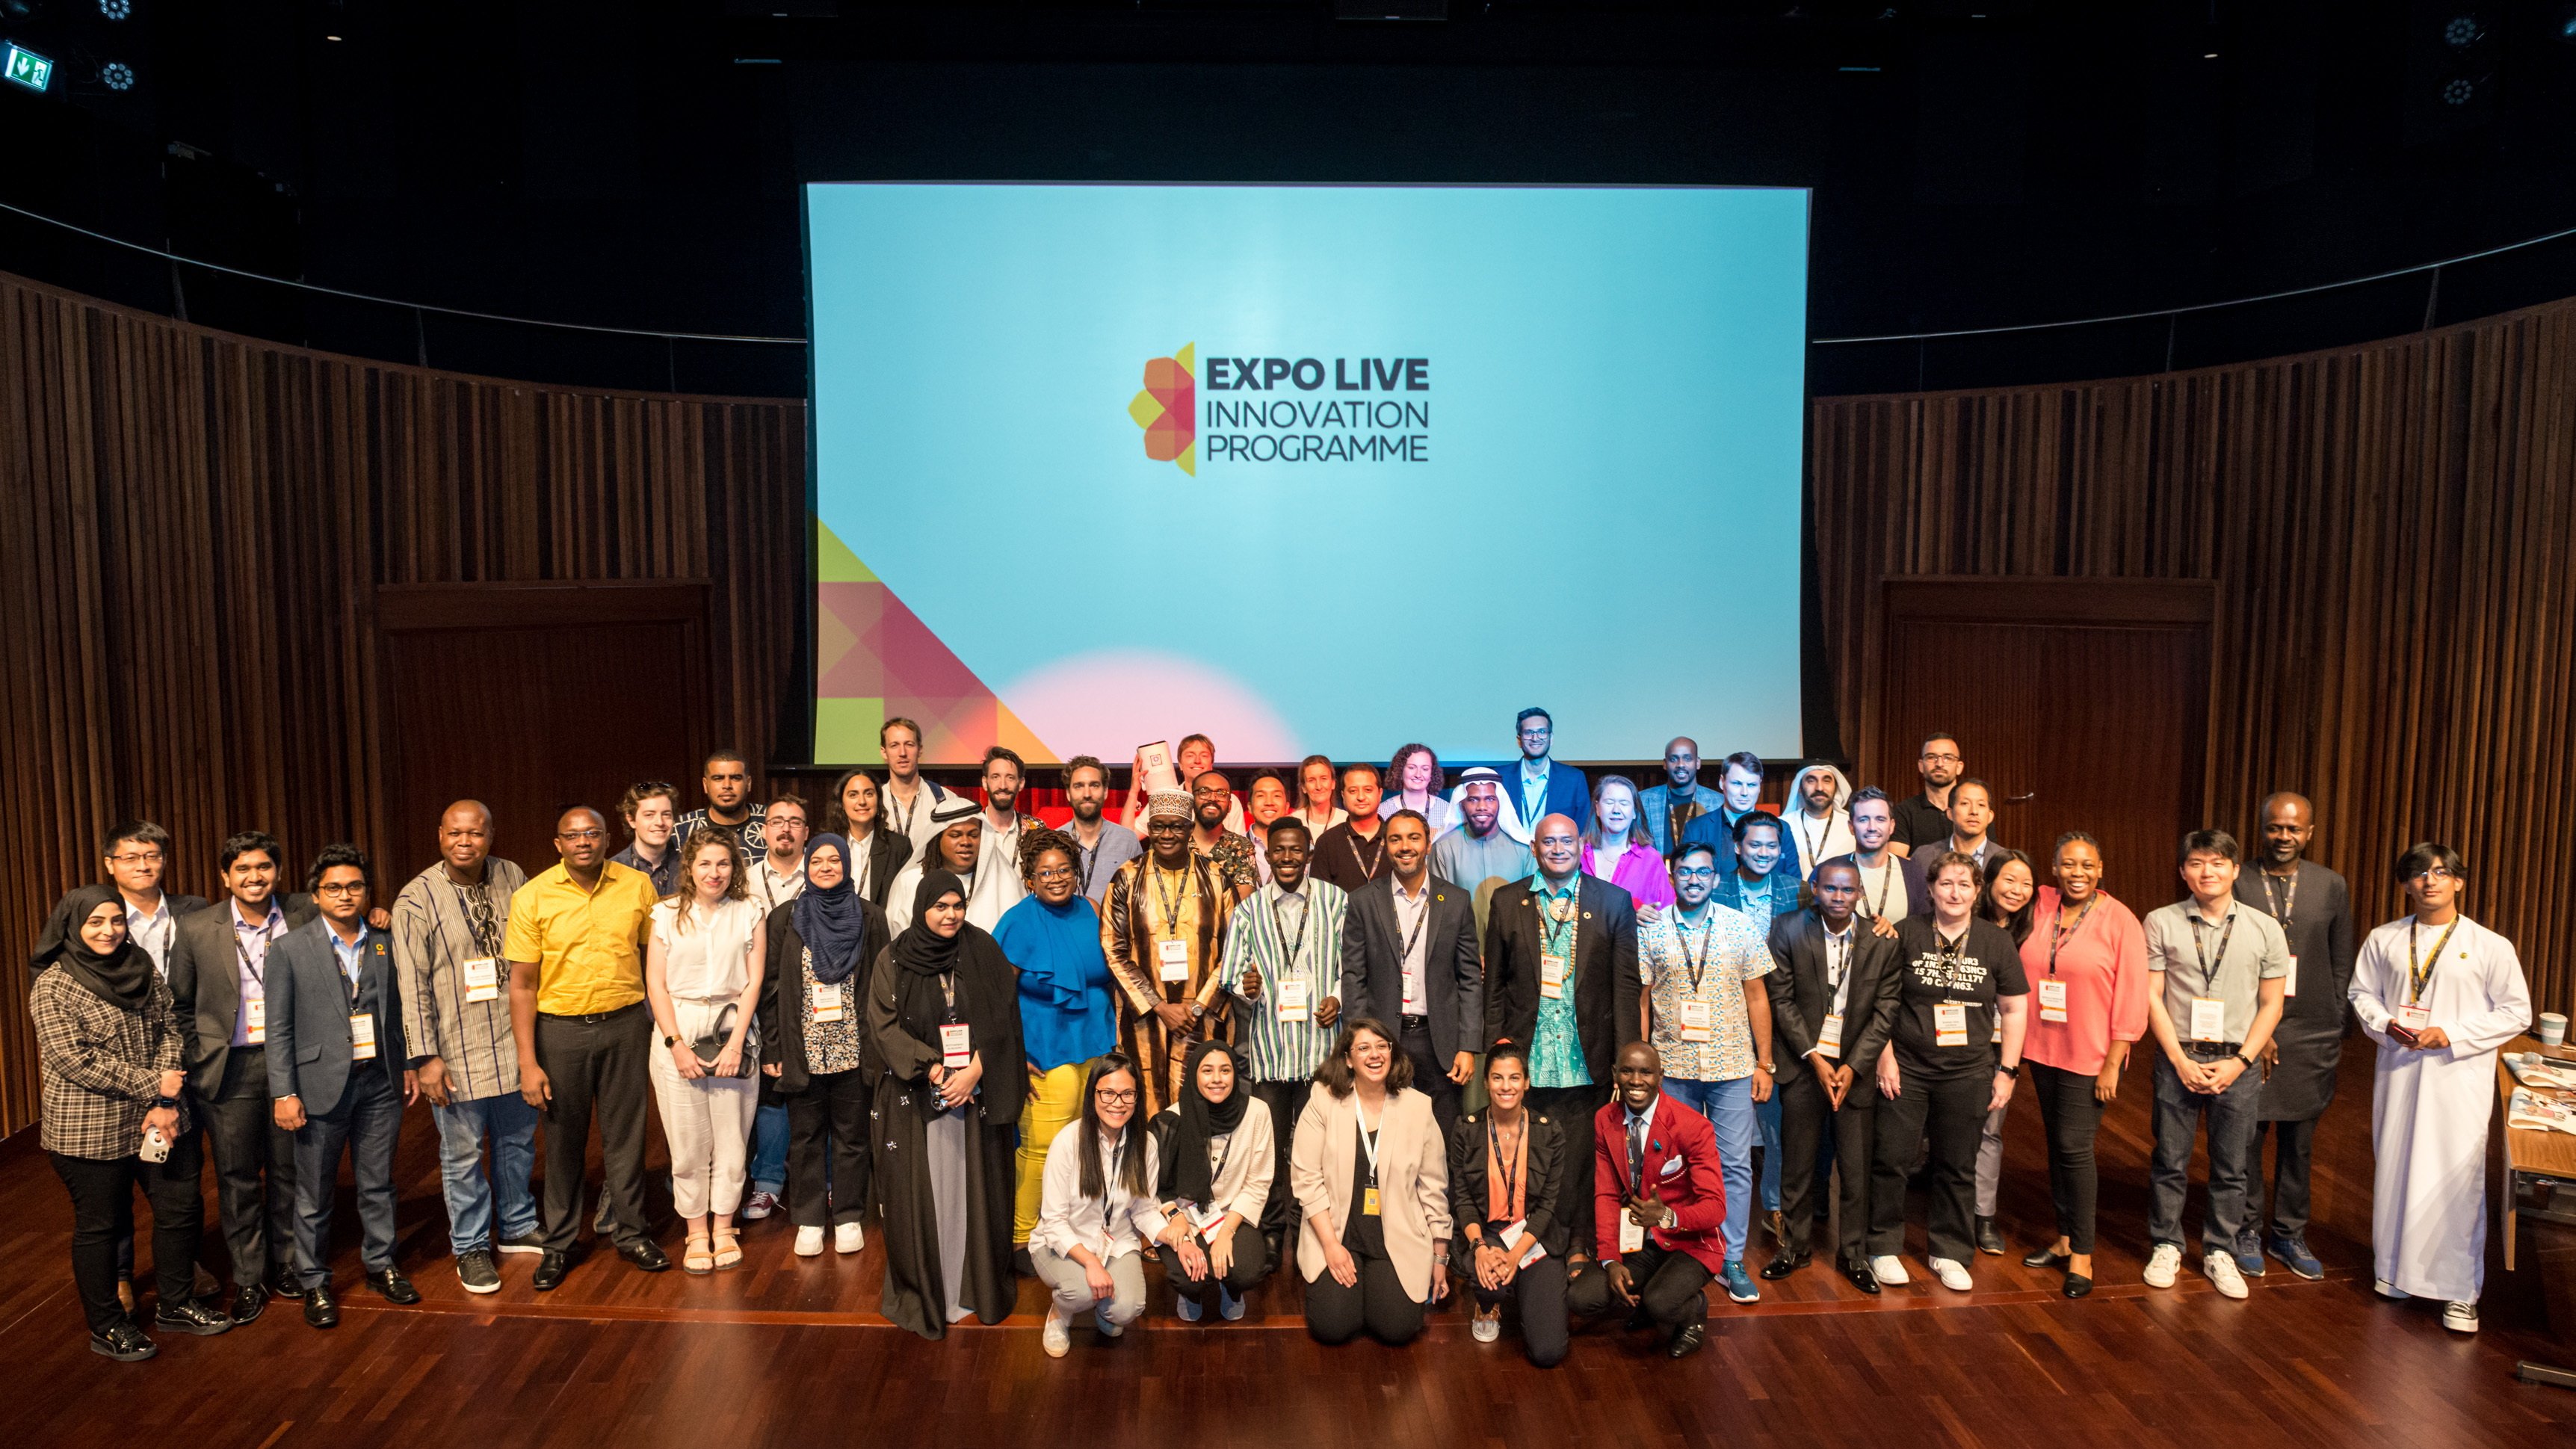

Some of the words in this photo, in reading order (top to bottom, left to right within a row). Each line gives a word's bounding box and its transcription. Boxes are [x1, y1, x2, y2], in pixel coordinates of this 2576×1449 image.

[1206, 357, 1326, 391] EXPO
[1335, 357, 1430, 391] LIVE
[1207, 401, 1429, 428] INNOVATION
[1207, 434, 1429, 462] PROGRAMME
